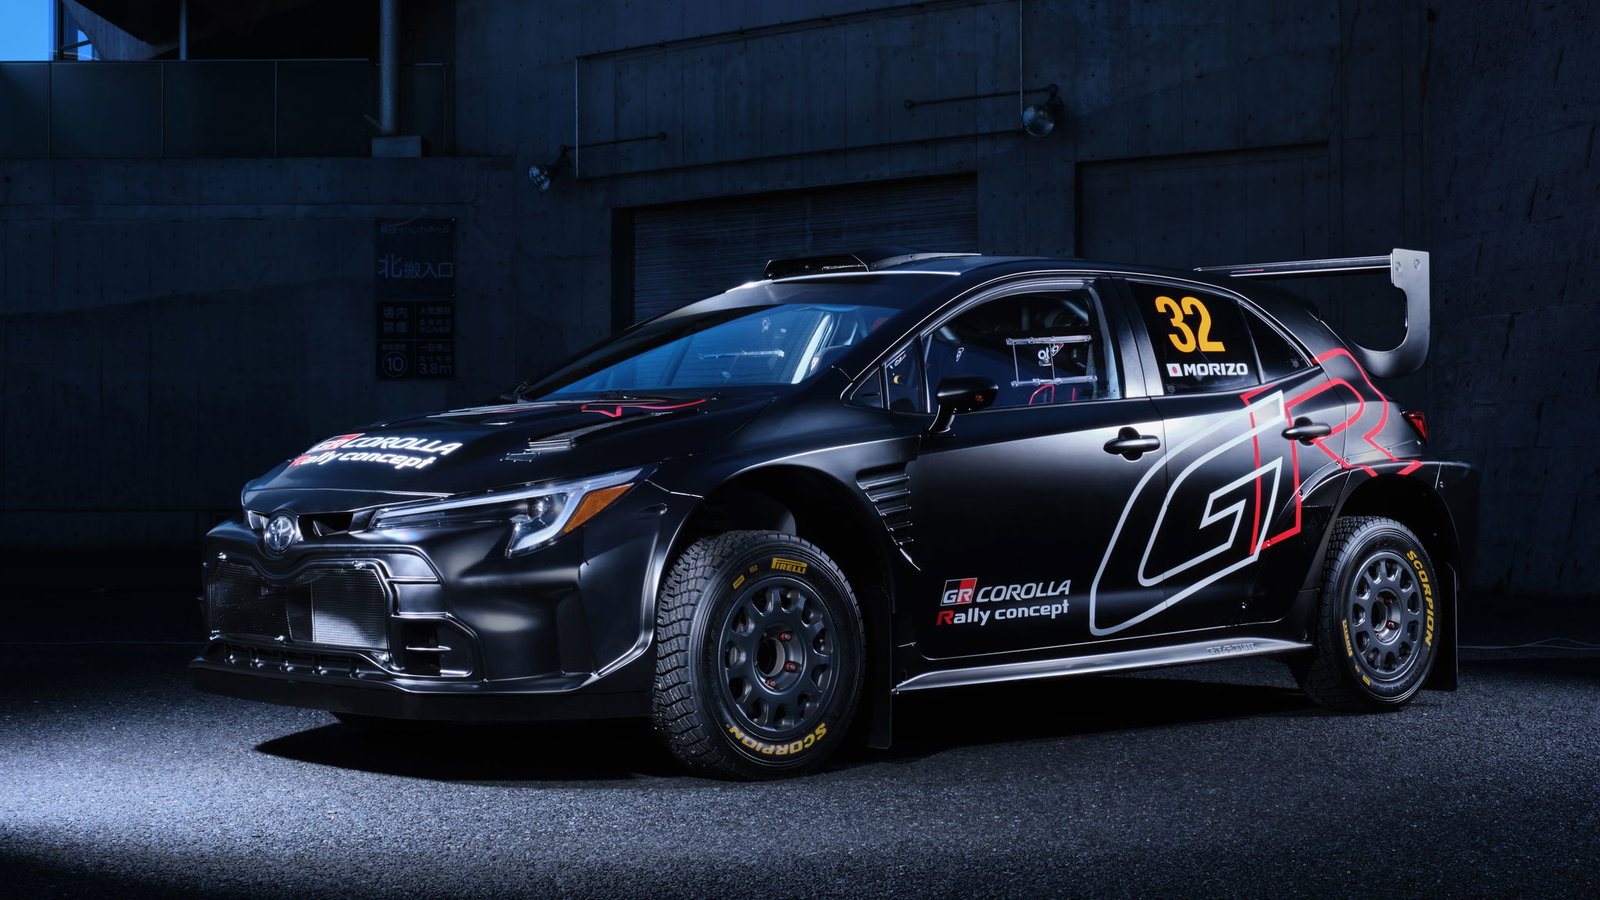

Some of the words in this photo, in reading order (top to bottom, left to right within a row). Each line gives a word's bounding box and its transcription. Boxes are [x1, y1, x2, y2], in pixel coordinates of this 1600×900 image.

[377, 253, 453, 279] 北搬入口
[1154, 296, 1226, 353] 32
[387, 356, 405, 373] 10
[1184, 363, 1248, 376] MORIZO
[341, 436, 463, 455] COROLLA
[288, 451, 343, 465] Rally
[338, 452, 437, 469] concept
[1090, 348, 1424, 637] GR
[771, 557, 807, 574] PIRELLI
[941, 583, 976, 605] GR
[976, 580, 1071, 602] COROLLA
[1406, 551, 1434, 647] SCORPION
[936, 607, 991, 626] Rally
[994, 600, 1069, 619] concept
[727, 722, 828, 755] SCORPION
